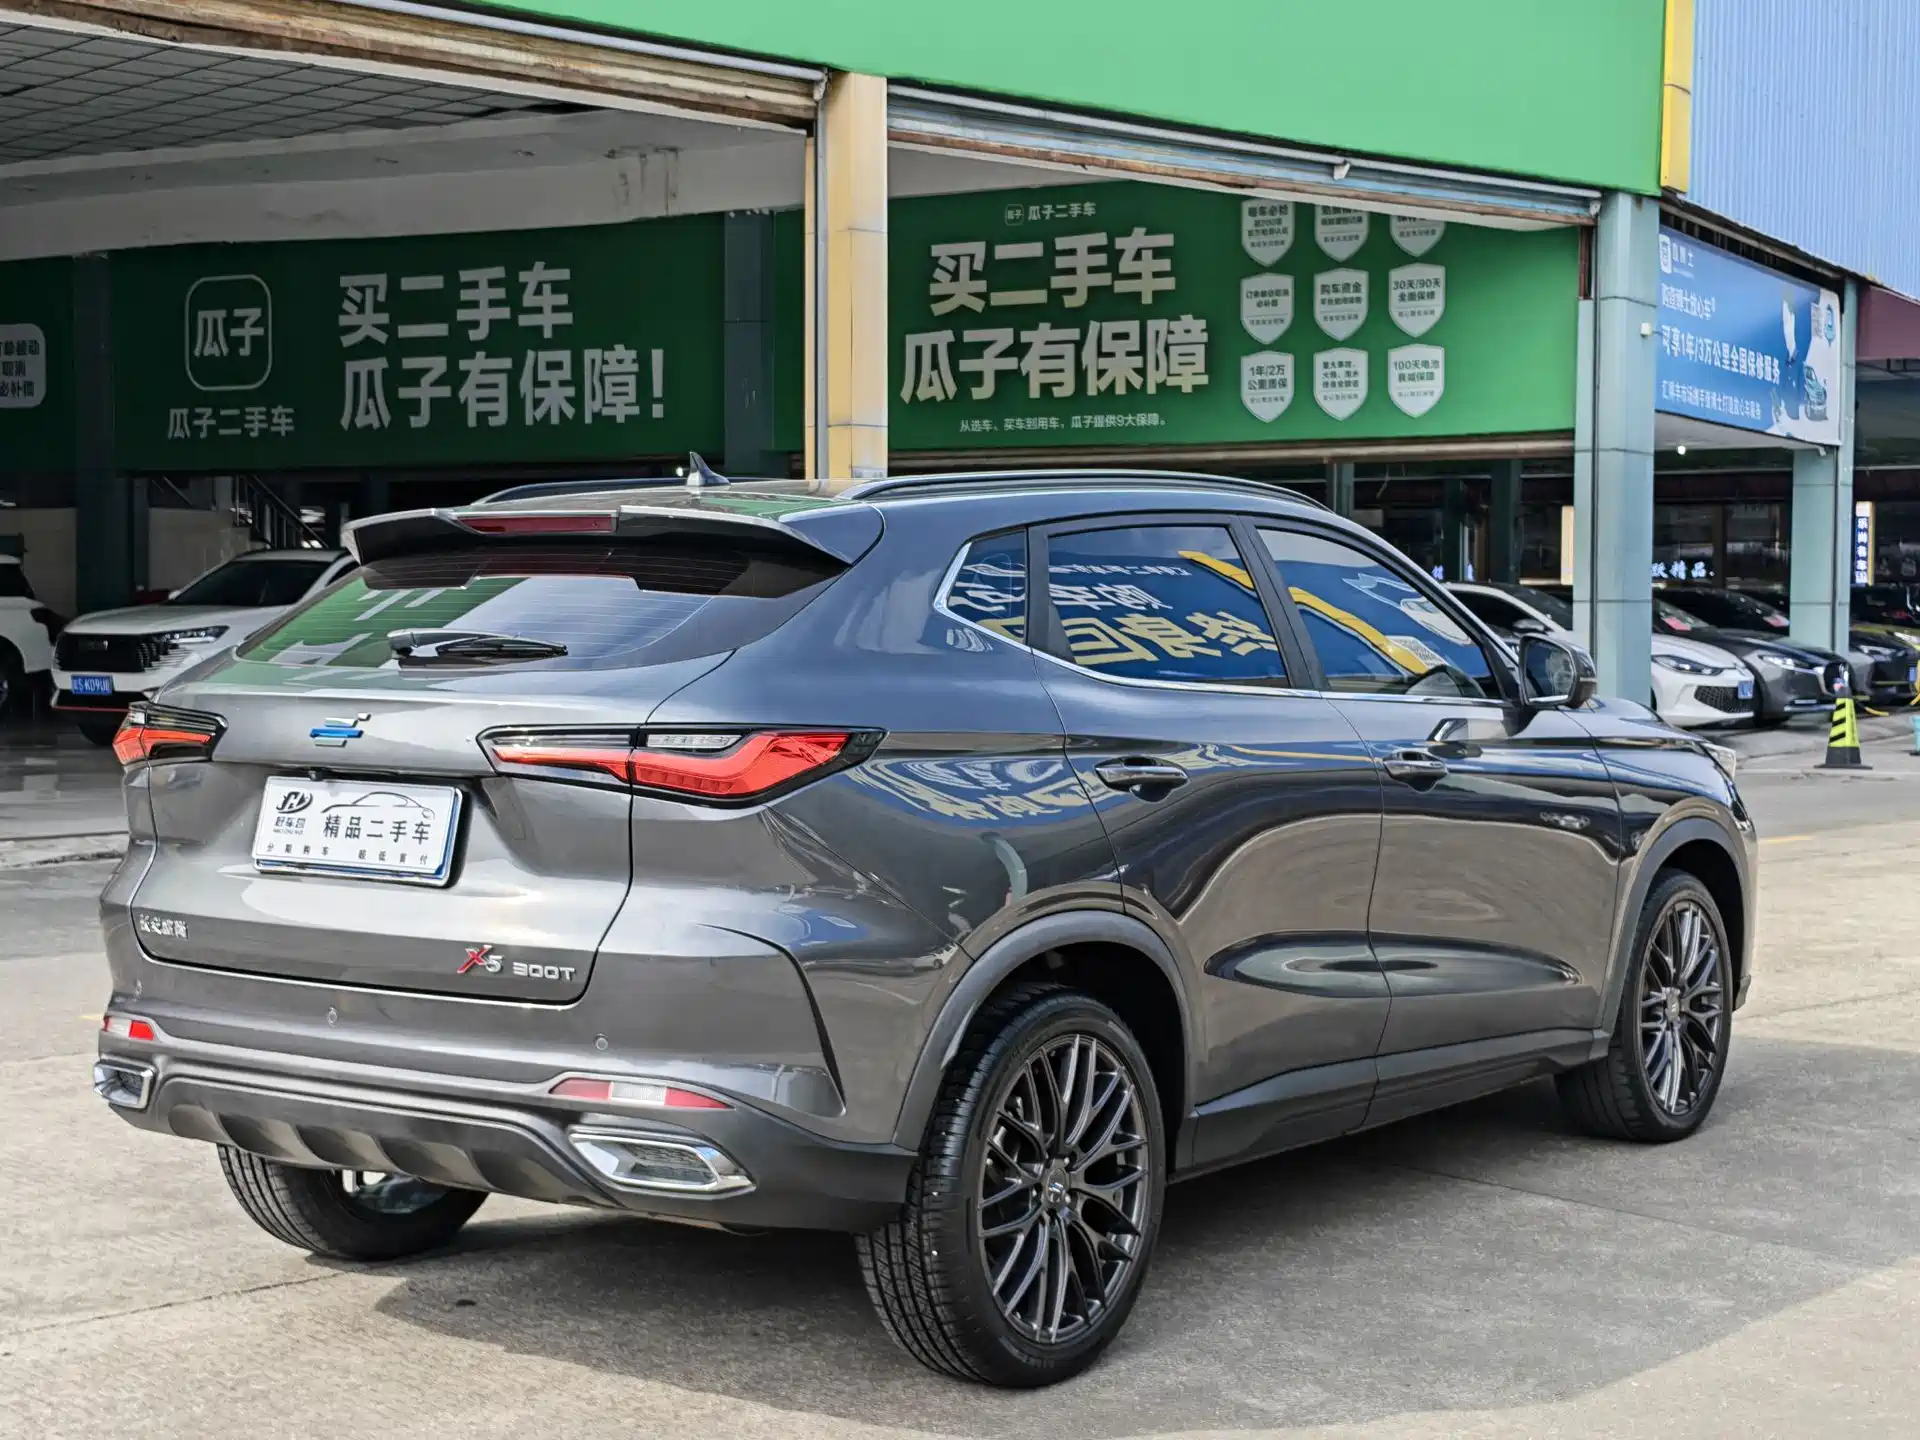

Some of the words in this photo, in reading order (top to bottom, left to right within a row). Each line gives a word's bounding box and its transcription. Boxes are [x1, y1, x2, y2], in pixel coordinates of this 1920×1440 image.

[1028, 202, 1097, 221] 瓜子二手车
[929, 227, 1176, 316] 买二手车
[338, 261, 574, 348] 买二手车
[194, 308, 266, 358] 瓜子
[900, 314, 1209, 404] 瓜子有保障
[1249, 364, 1286, 377] 1年/2万
[340, 344, 666, 430] 瓜子有保障!
[167, 406, 295, 440] 瓜子二手车
[323, 814, 431, 845] 精品二手车
[456, 944, 503, 974] X5
[512, 961, 575, 980] 300T
